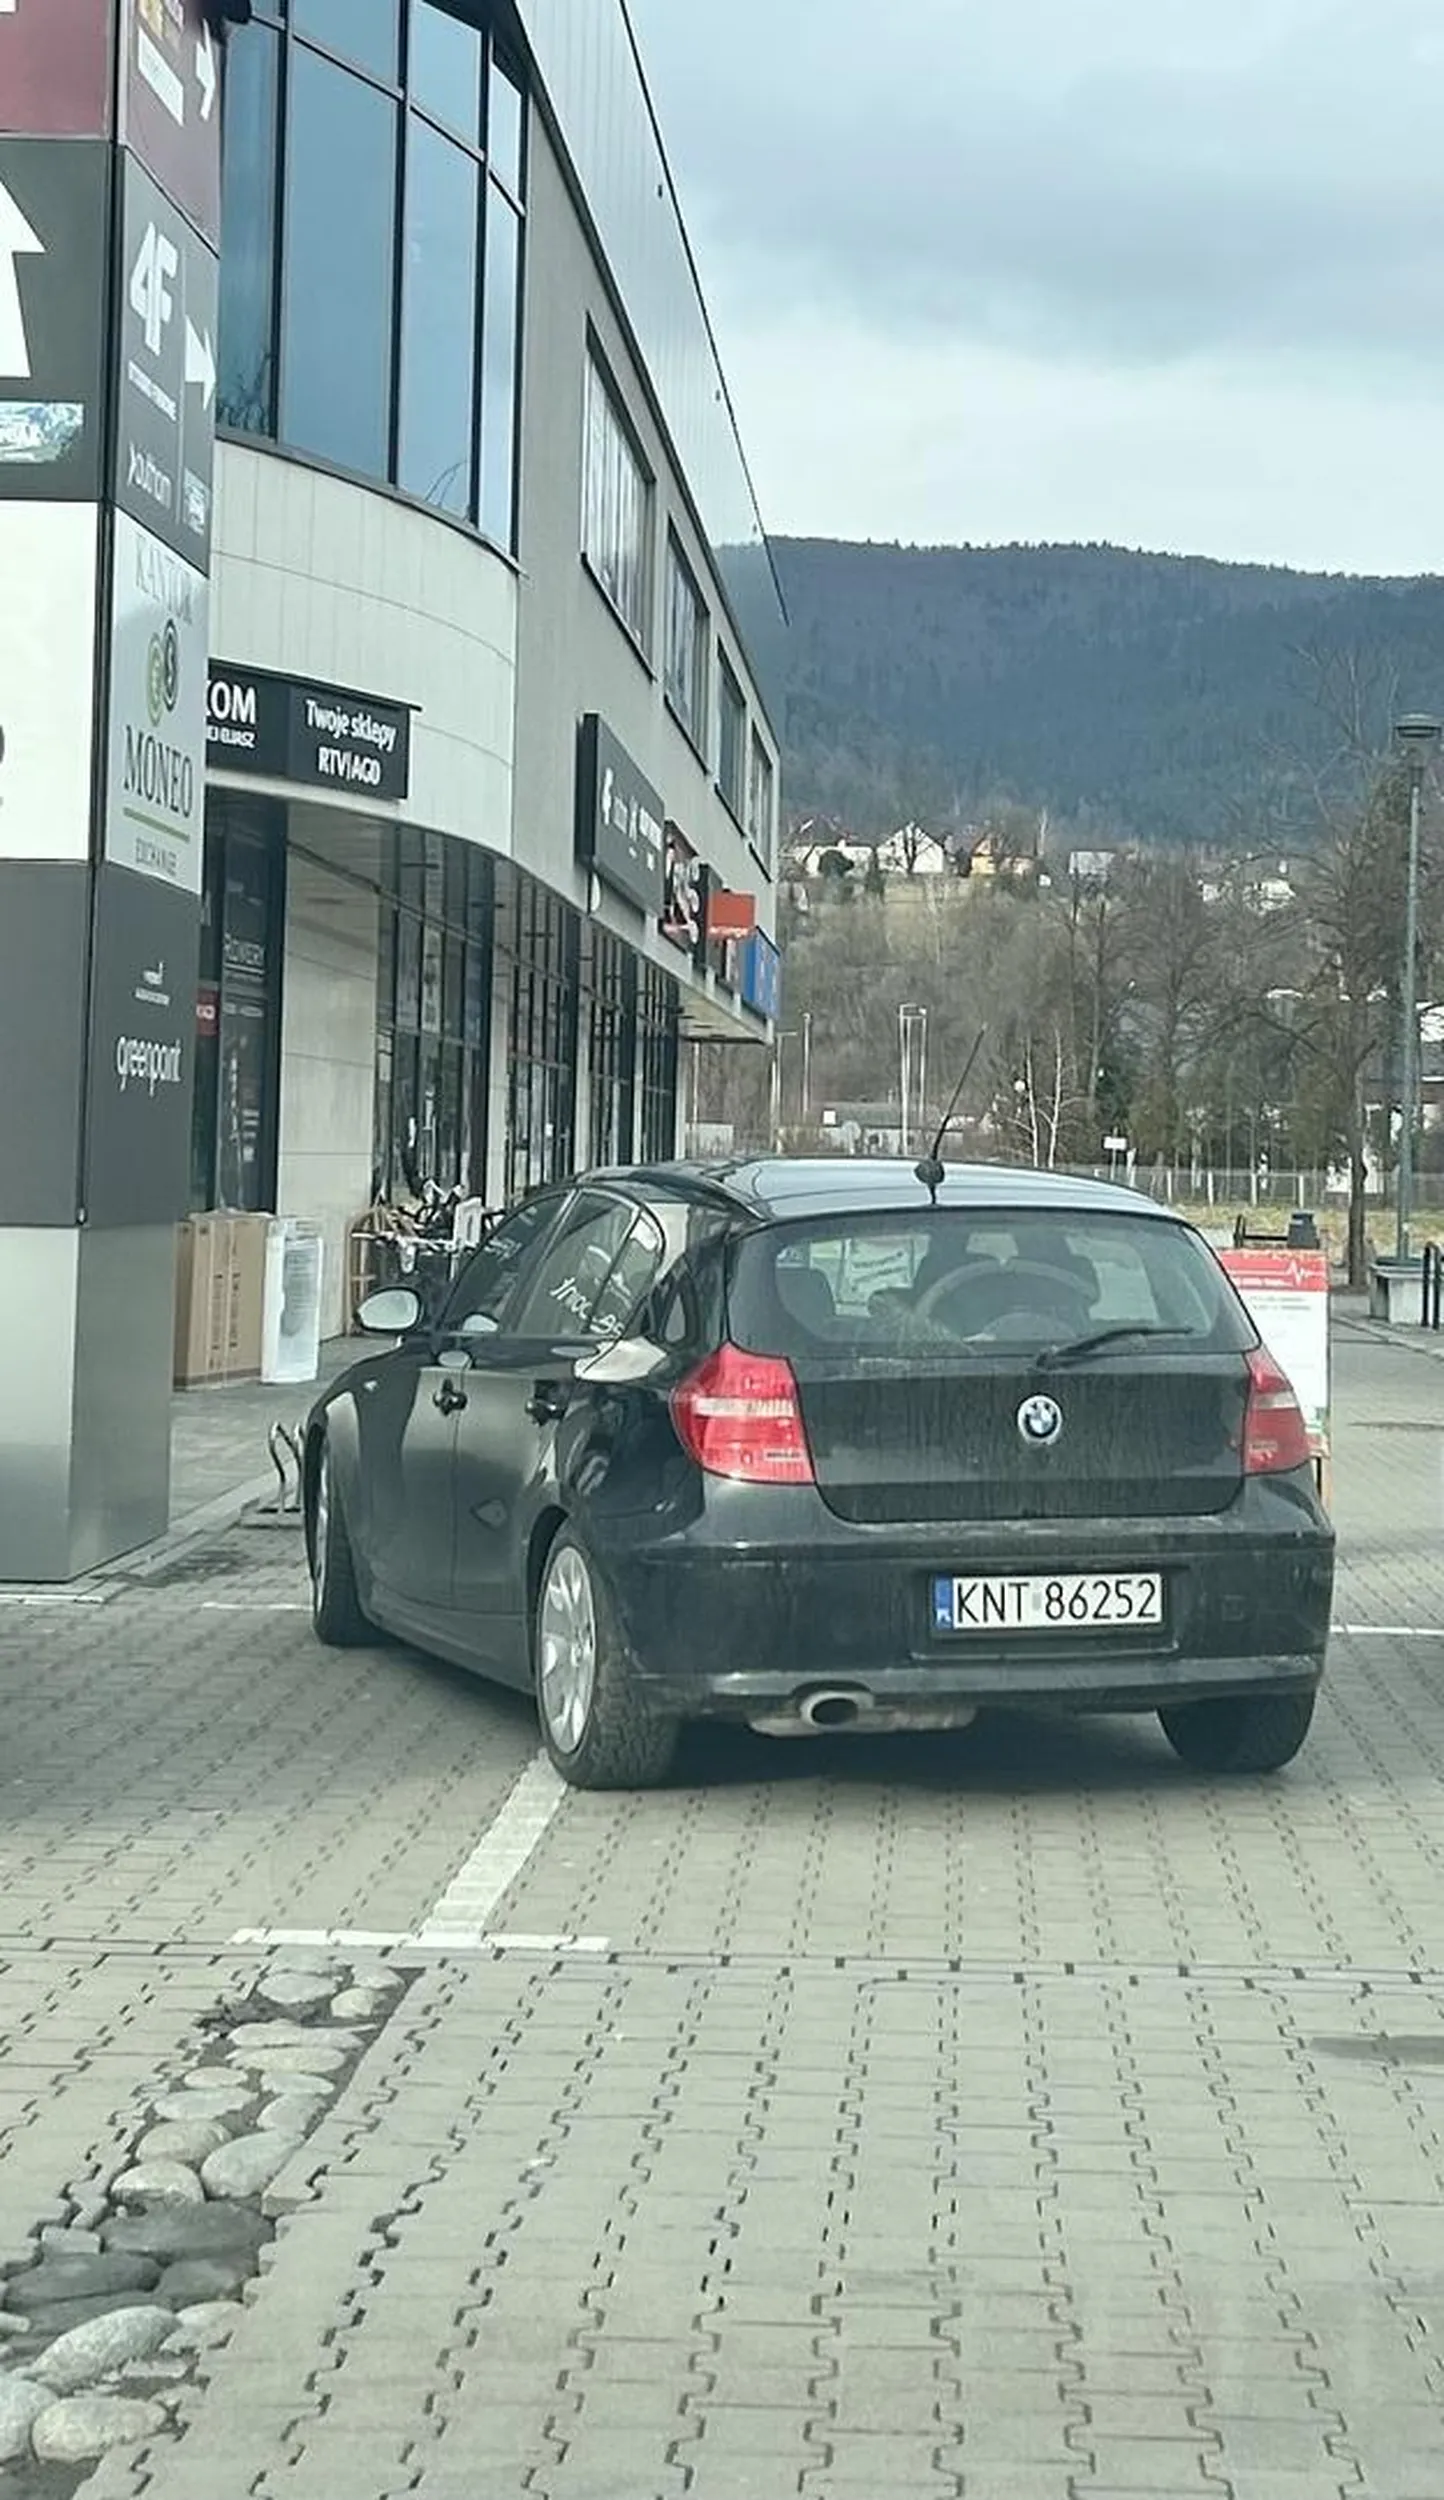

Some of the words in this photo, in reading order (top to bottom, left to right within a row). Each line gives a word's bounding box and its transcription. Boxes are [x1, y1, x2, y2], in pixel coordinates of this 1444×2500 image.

[130, 221, 179, 357] 4F
[305, 699, 350, 739] Twoje
[351, 711, 397, 753] sklepy
[123, 724, 193, 819] MONEO
[117, 1036, 181, 1097] greenpoint
[957, 1582, 1030, 1623] KNT
[1045, 1579, 1157, 1621] 86252
